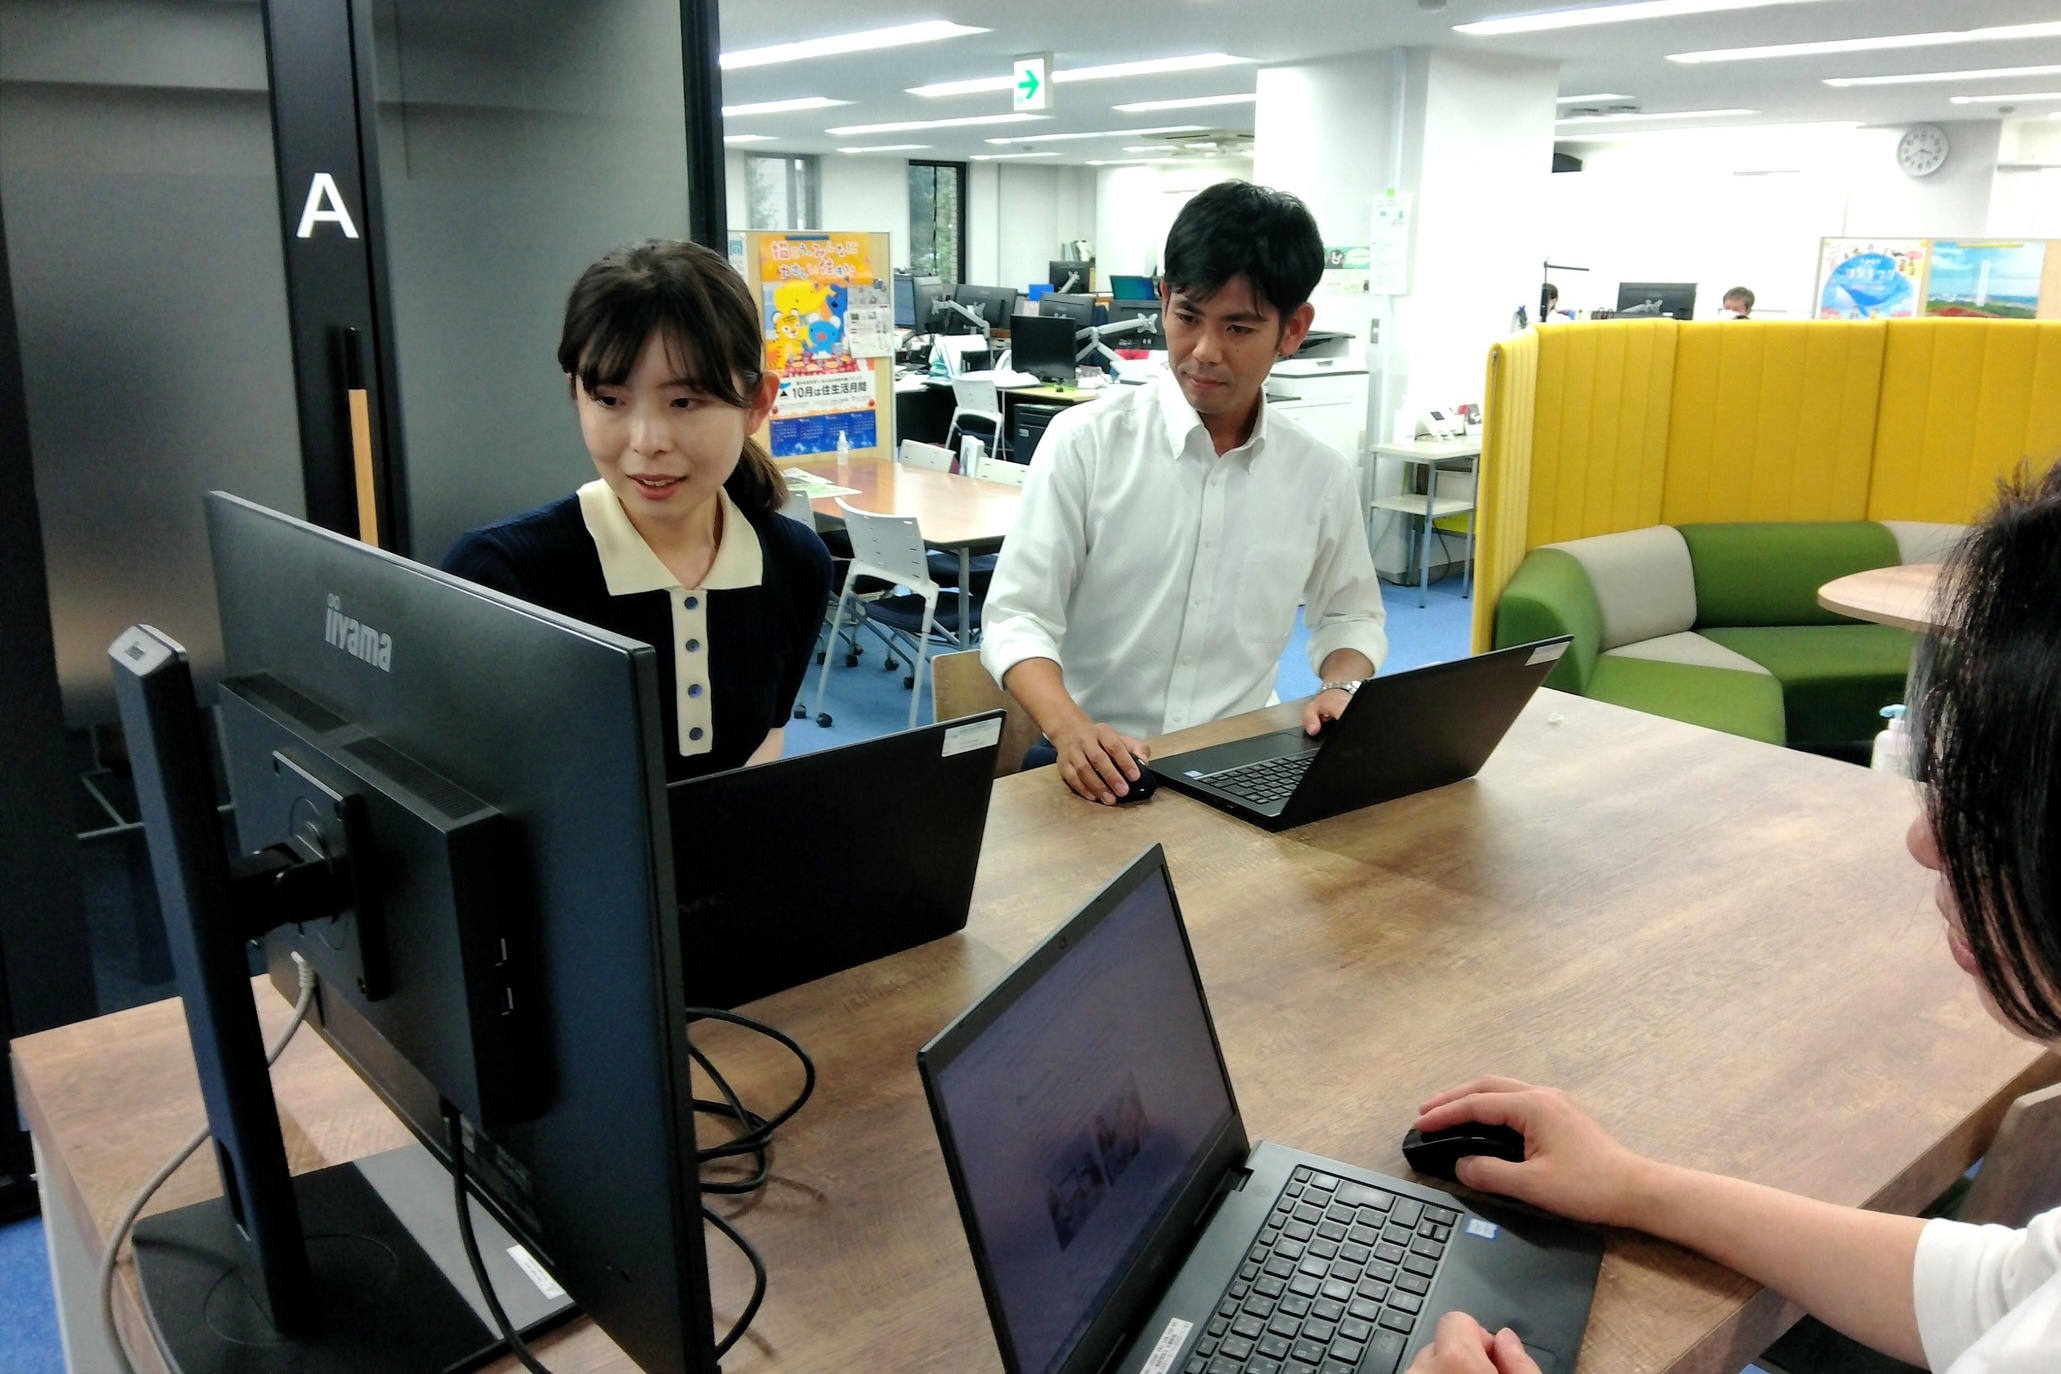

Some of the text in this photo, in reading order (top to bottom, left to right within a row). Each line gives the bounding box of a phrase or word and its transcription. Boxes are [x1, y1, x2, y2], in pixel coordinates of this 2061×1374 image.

[296, 172, 360, 239] A
[792, 381, 867, 398] 10月は住生活月間
[325, 593, 393, 672] iiyama
